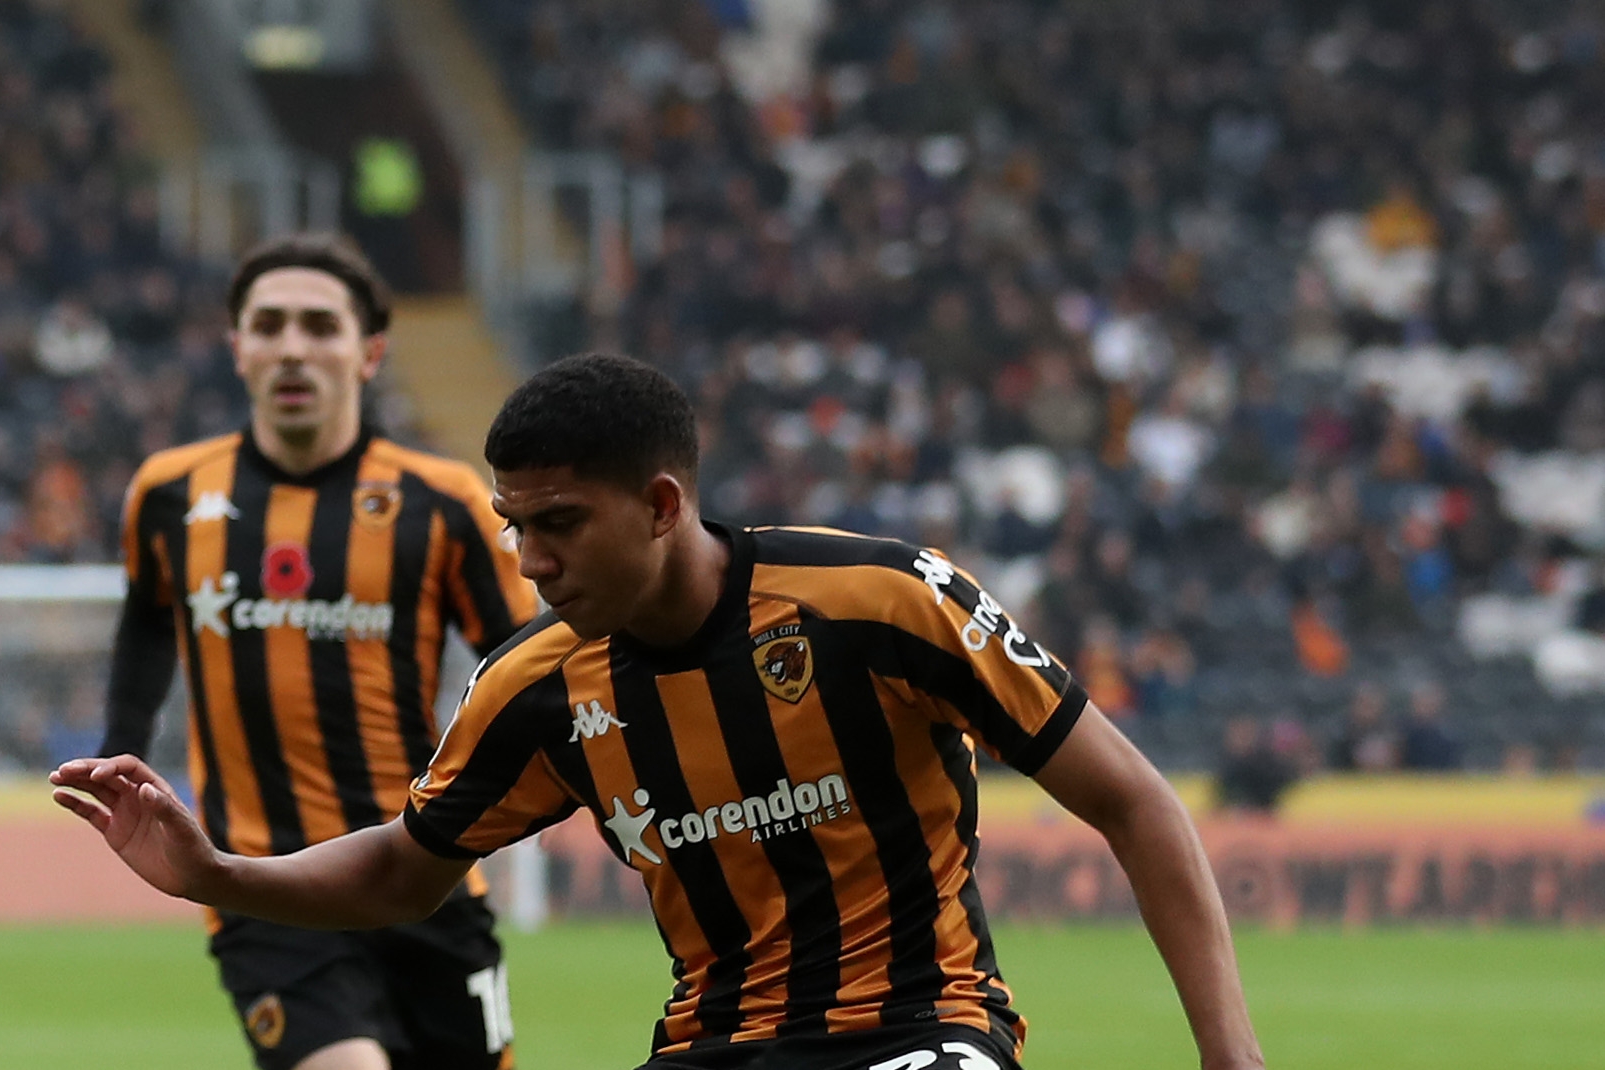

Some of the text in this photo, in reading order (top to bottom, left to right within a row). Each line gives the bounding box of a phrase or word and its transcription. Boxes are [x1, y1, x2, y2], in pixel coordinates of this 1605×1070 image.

[232, 594, 393, 632] corendon
[778, 625, 800, 636] CITY
[659, 774, 847, 849] corendon
[751, 802, 851, 843] AIRLINES
